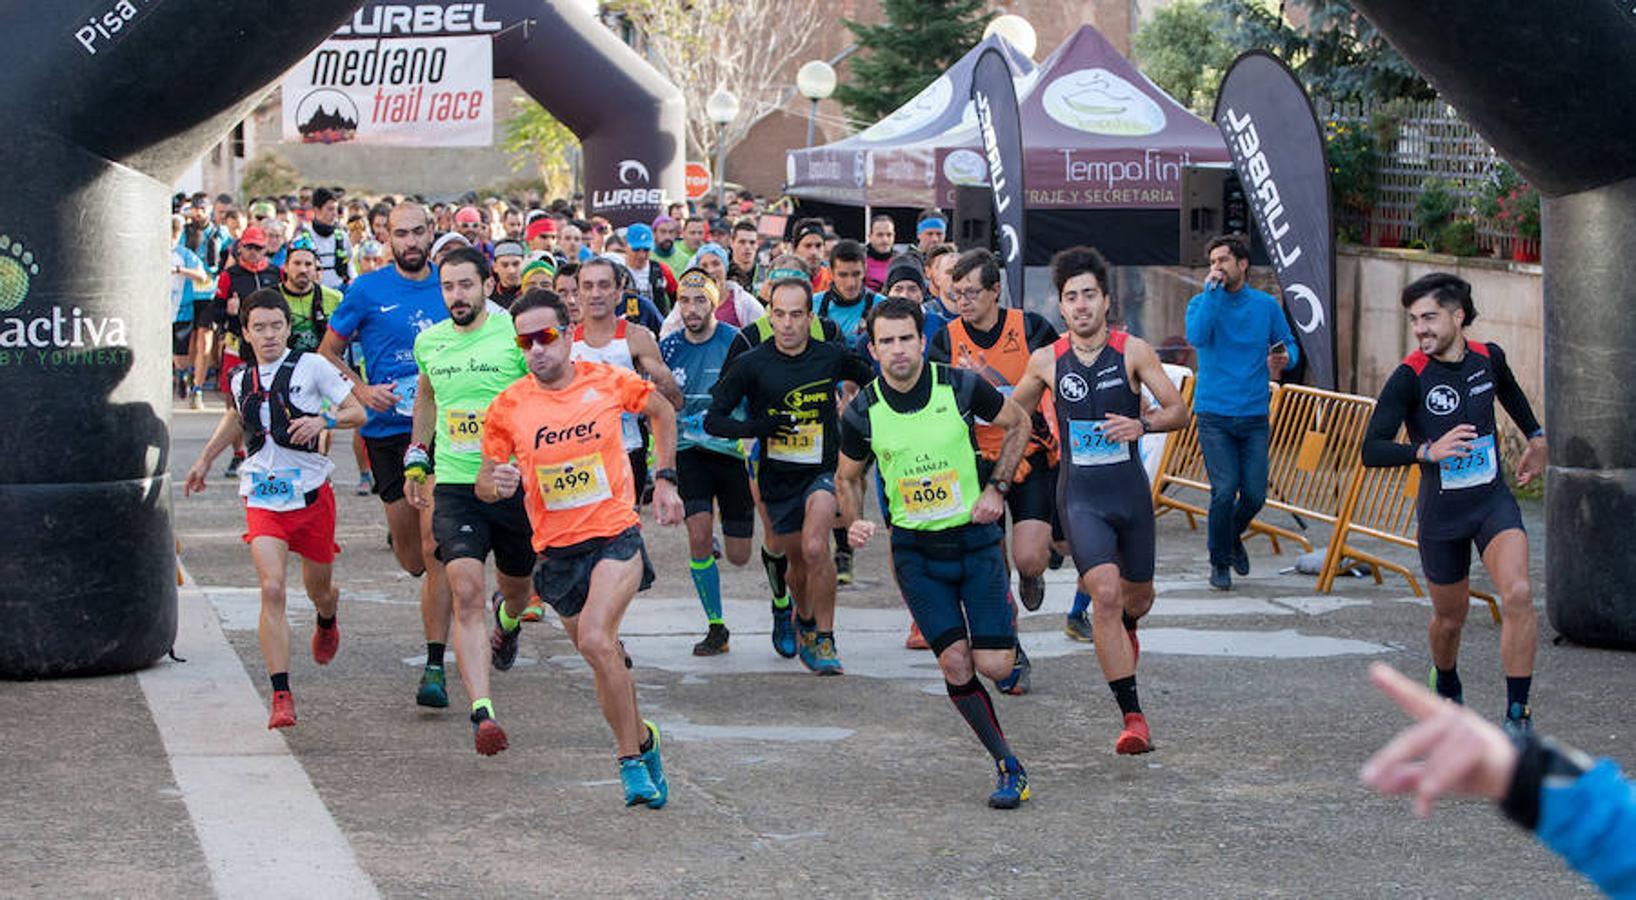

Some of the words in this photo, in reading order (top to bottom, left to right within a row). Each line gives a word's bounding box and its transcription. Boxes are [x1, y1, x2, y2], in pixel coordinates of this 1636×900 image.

[310, 46, 447, 86] medrano
[371, 86, 422, 124] trail
[427, 89, 484, 122] race
[685, 175, 706, 187] TOP
[592, 188, 674, 209] LURBEL
[1069, 190, 1080, 204] Y
[0, 306, 129, 348] activa
[457, 420, 484, 435] 40
[259, 481, 289, 496] 263
[553, 470, 590, 491] 499
[912, 486, 948, 503] 406
